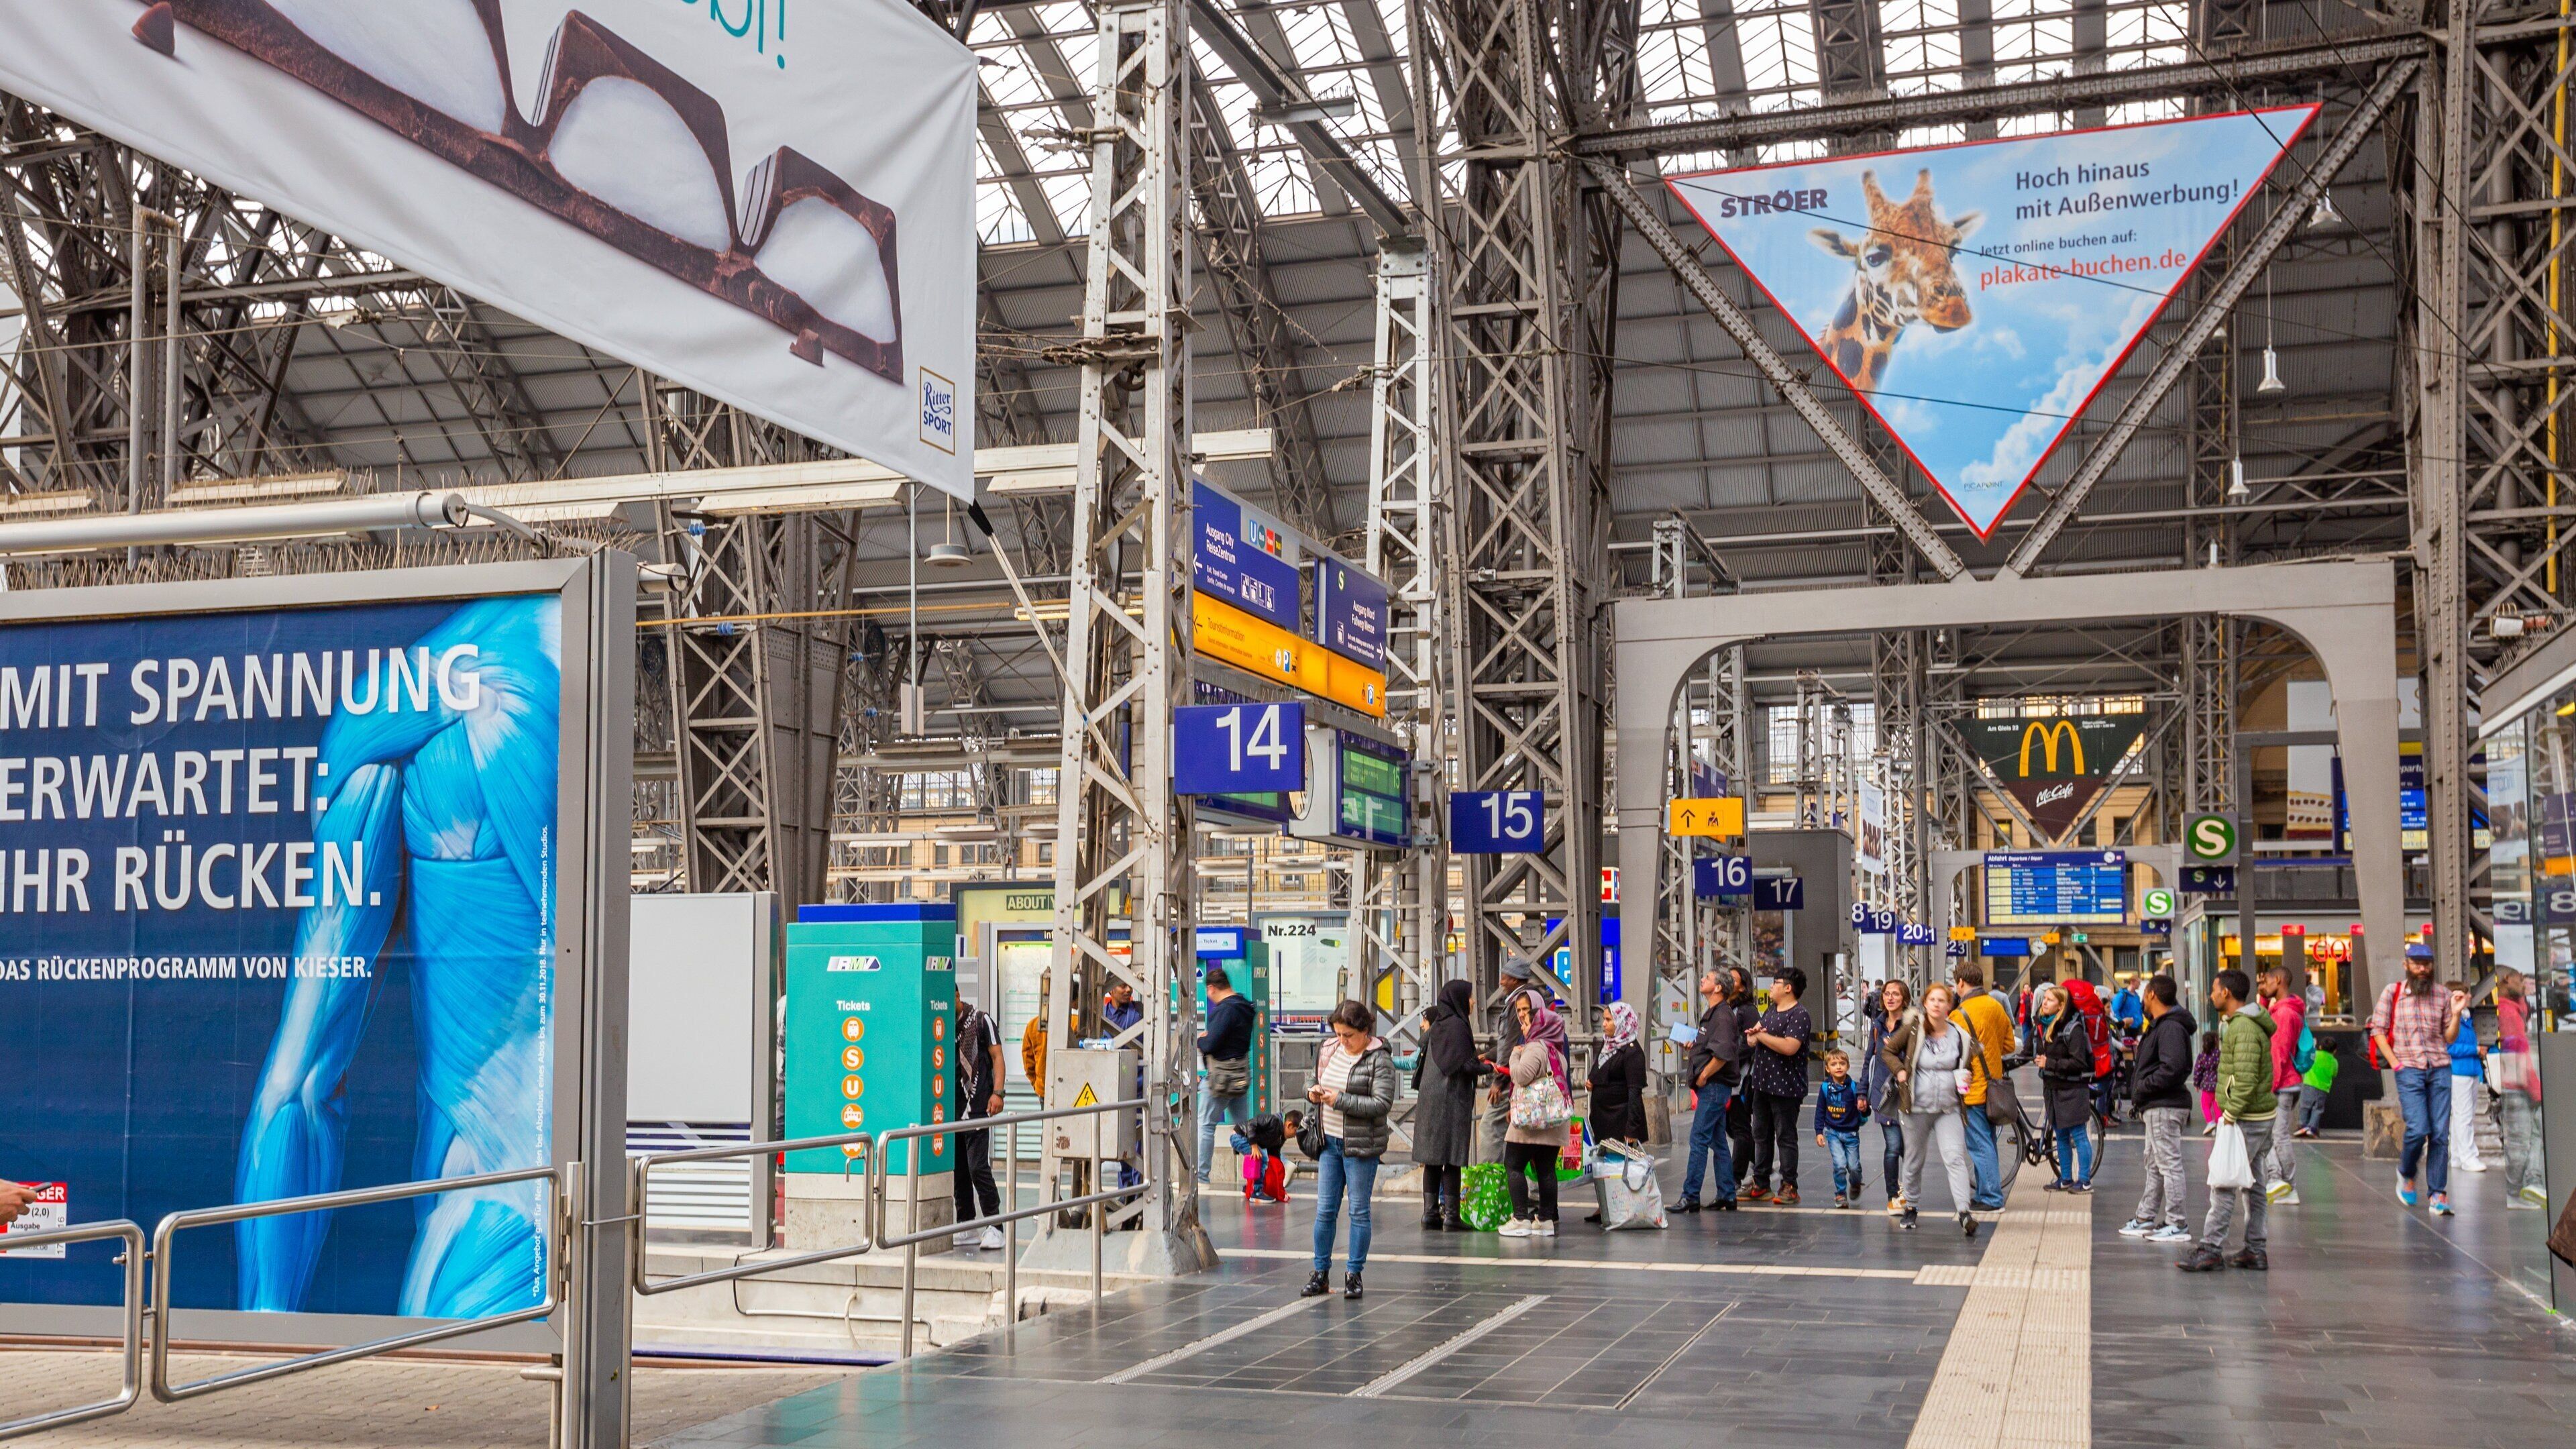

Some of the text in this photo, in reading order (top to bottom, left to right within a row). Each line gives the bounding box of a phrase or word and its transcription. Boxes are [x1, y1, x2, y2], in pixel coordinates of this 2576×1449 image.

[2016, 162, 2149, 191] Hoch hinaus
[1721, 189, 1828, 218] STRÖER
[2016, 178, 2239, 220] mit Außenwerbung!
[1979, 229, 2137, 257] Jetzt online buchen auf:
[1980, 248, 2187, 291] plakate-buchen.de
[923, 382, 951, 415] Ritter
[924, 410, 951, 435] SPORT
[1206, 523, 1234, 549] Ausgang City
[1250, 521, 1256, 542] U
[1206, 539, 1236, 564] ReiseZentrum
[1338, 570, 1344, 590] S
[1208, 617, 1245, 642] Touristinformation
[0, 644, 480, 730] MIT SPANNUNG
[1217, 704, 1287, 771] 14
[0, 746, 329, 820] ERWARTET:
[1481, 792, 1534, 839] 15
[2196, 820, 2226, 856] S
[115, 830, 380, 912] RÜCKEN.
[1711, 857, 1746, 886] 16
[1771, 878, 1798, 903] 17
[1008, 896, 1046, 910] ABOUT
[2149, 892, 2168, 914] S
[540, 928, 547, 936] in
[1268, 925, 1316, 936] Nr.224
[1872, 912, 1892, 930] 19
[1903, 924, 1923, 940] 20
[1925, 928, 1935, 942] 1
[38, 956, 236, 979] RÜCKENPROGRAMM
[242, 957, 286, 978] VON
[294, 957, 372, 978] KIESER.
[837, 1000, 870, 1011] Tickets
[930, 1000, 948, 1010] Tickets
[847, 1049, 859, 1067] S
[935, 1049, 942, 1066] S
[847, 1080, 859, 1095] U
[935, 1080, 941, 1094] U
[32, 1208, 50, 1218] (2,0)
[10, 1222, 40, 1230] Ausgabe
[534, 1218, 542, 1233] gilt
[533, 1235, 541, 1274] Angebot
